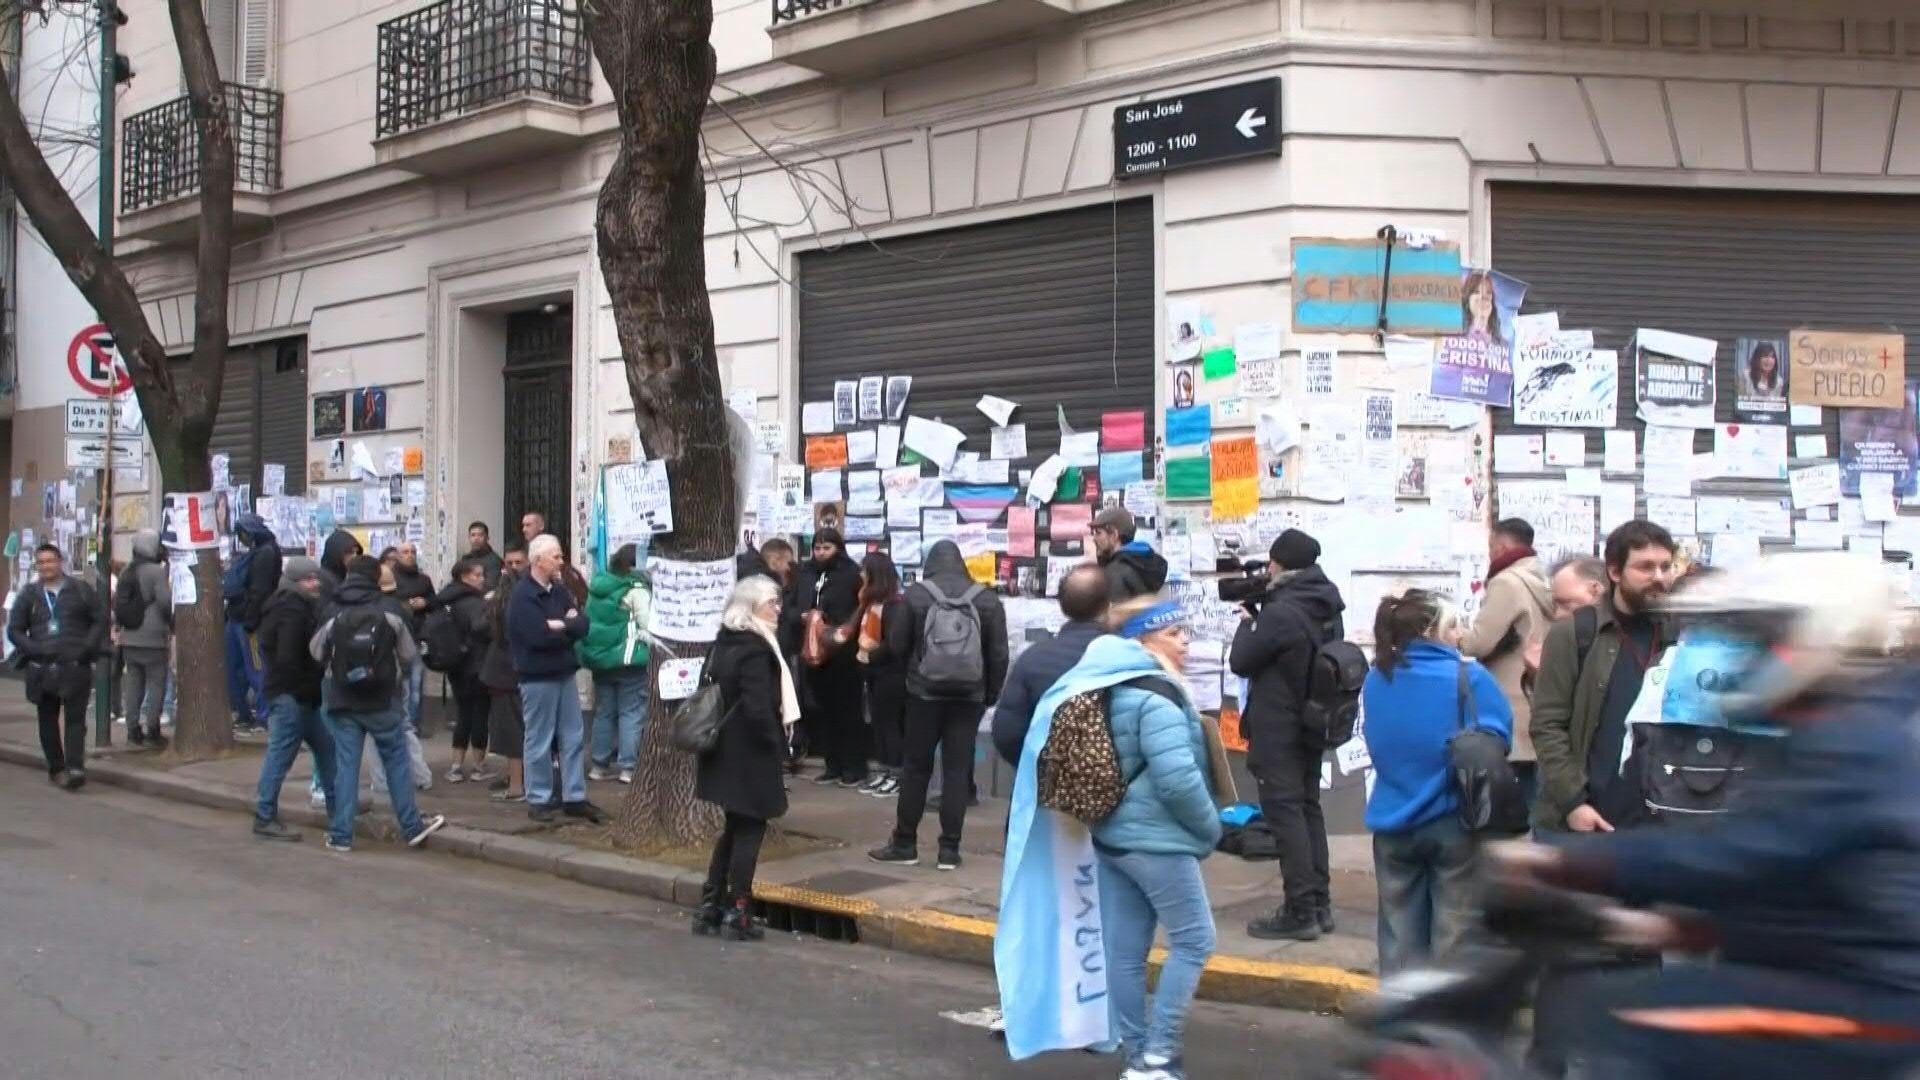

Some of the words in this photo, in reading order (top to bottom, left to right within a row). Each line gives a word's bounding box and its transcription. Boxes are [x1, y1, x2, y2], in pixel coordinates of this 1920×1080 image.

[1126, 110, 1150, 123] San
[1153, 101, 1184, 118] José
[1127, 142, 1156, 158] 1200
[1168, 134, 1197, 150] 1100
[1126, 161, 1160, 173] Comuna
[1163, 158, 1167, 168] 1
[1443, 337, 1487, 353] TODOS
[1520, 349, 1592, 362] FORMOSA
[1439, 347, 1513, 373] CRISTINA
[1814, 370, 1885, 397] PUEBLO
